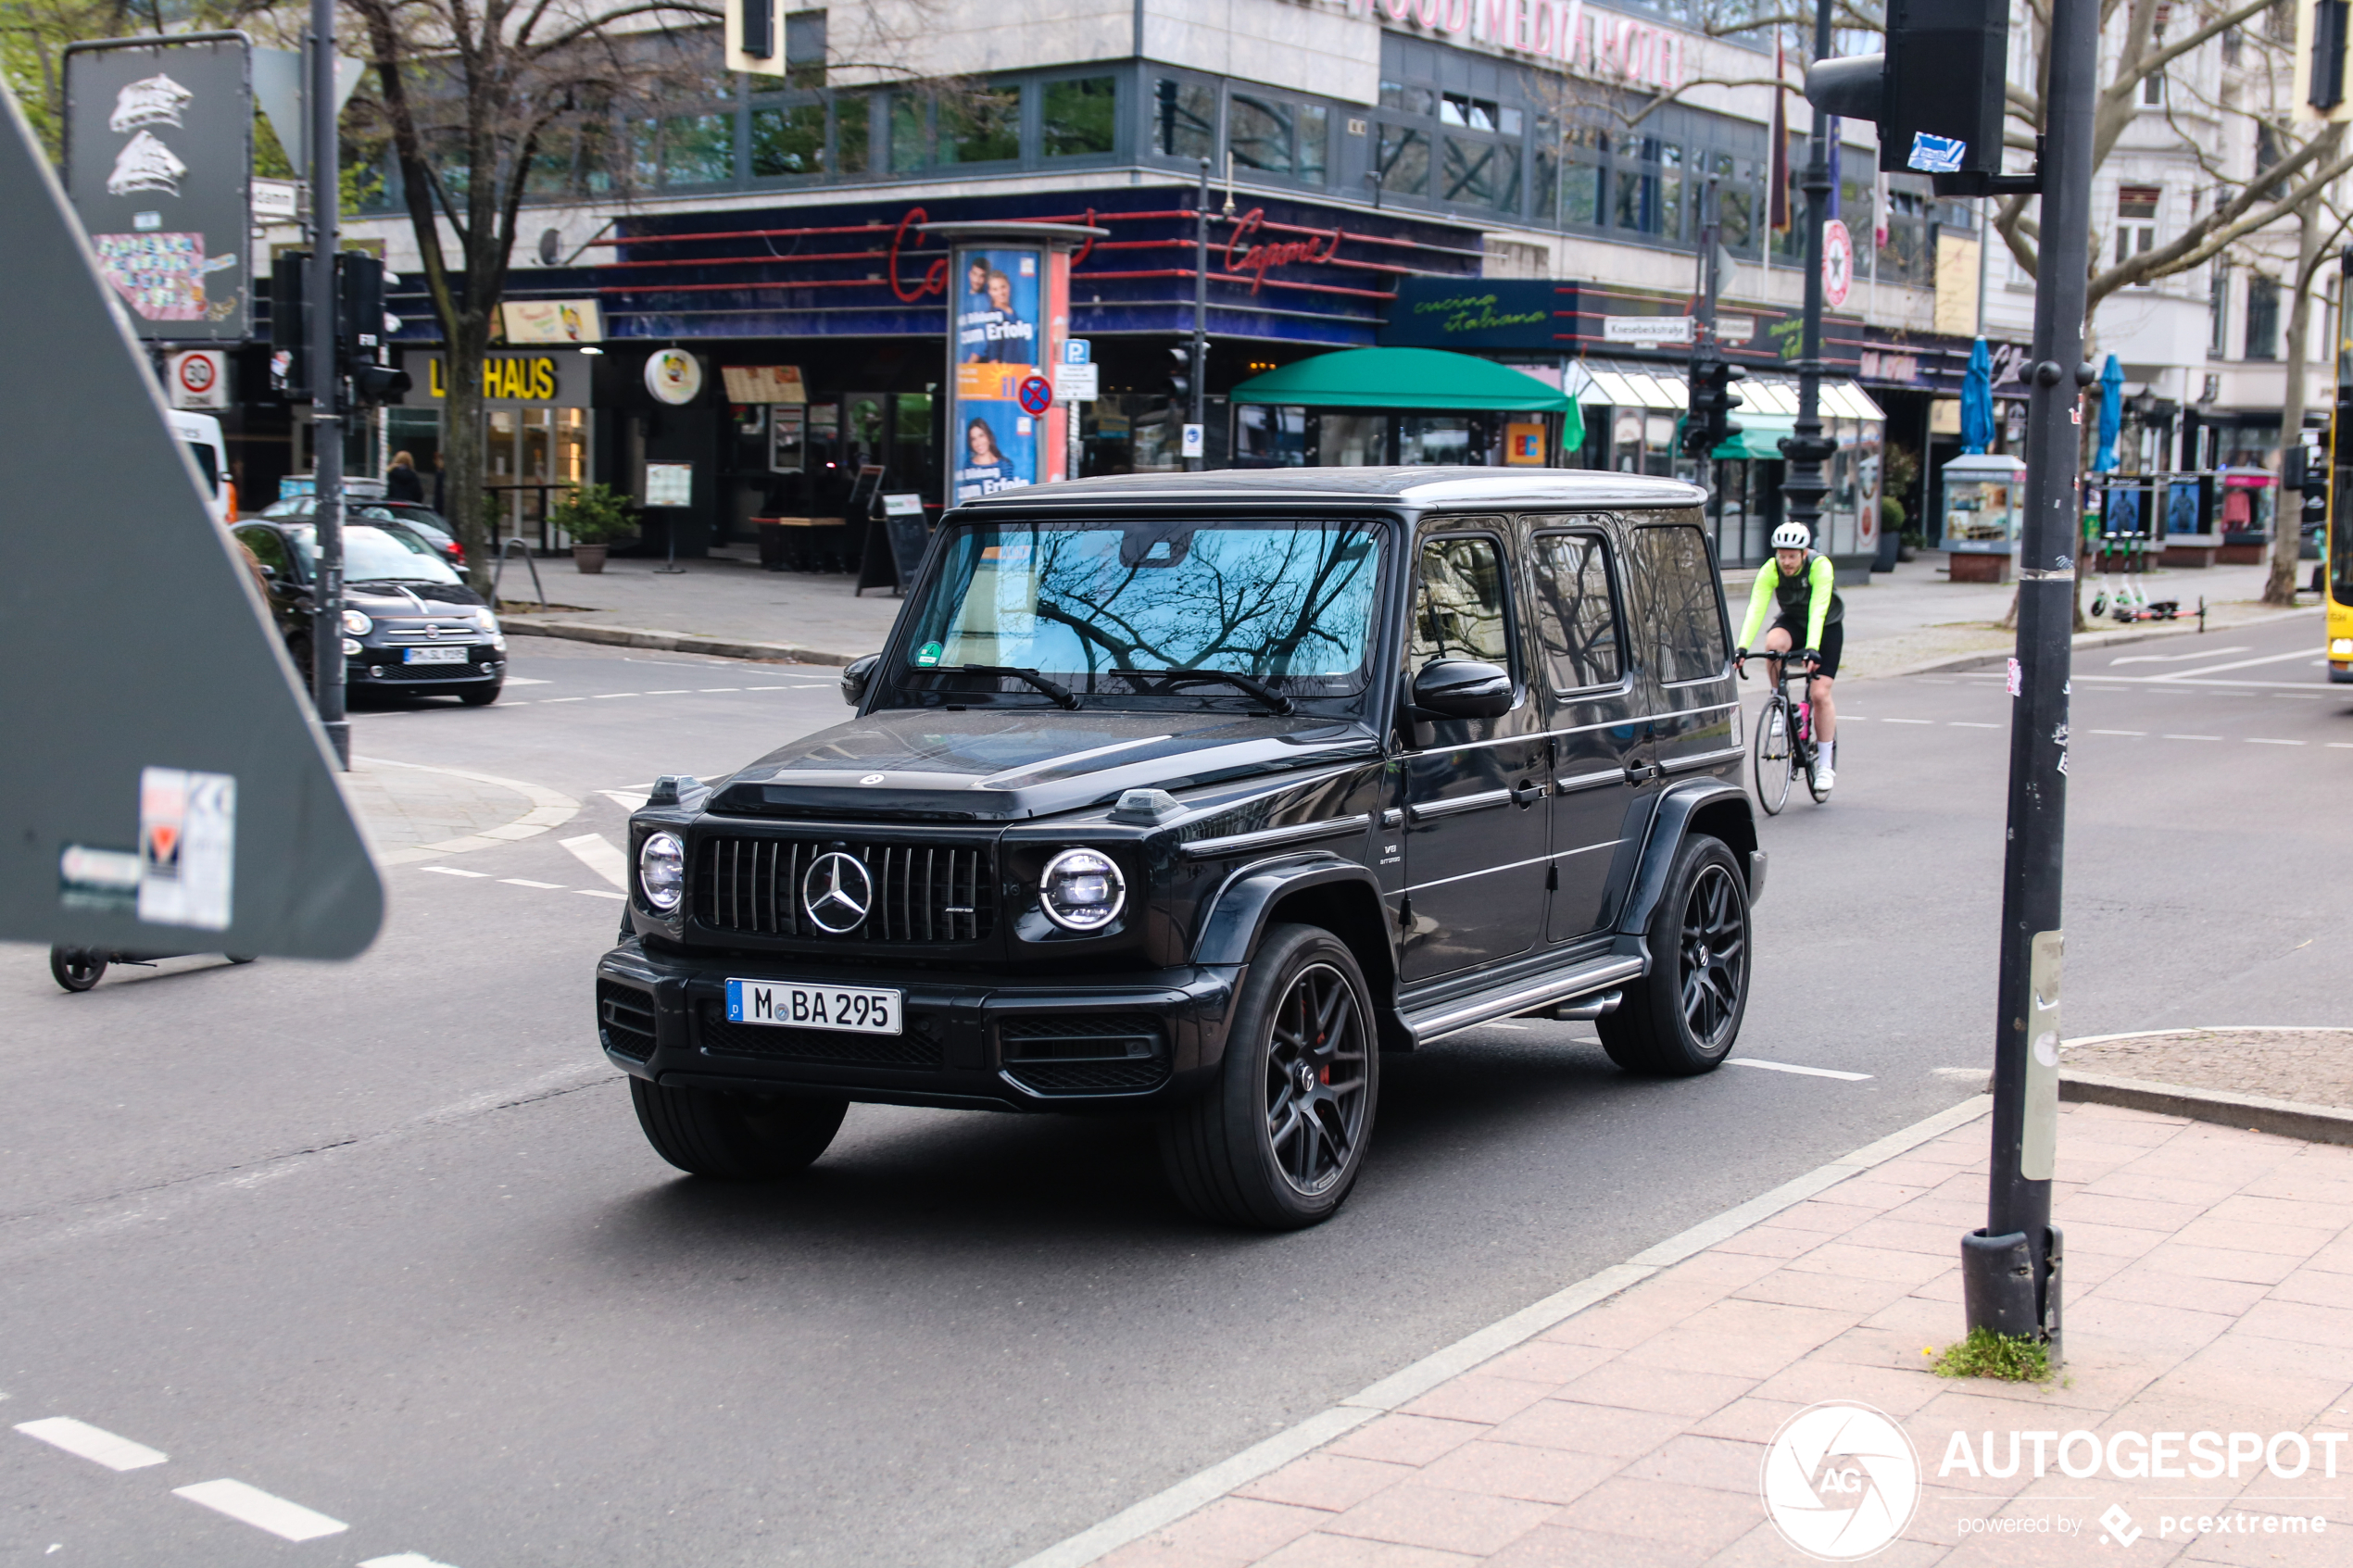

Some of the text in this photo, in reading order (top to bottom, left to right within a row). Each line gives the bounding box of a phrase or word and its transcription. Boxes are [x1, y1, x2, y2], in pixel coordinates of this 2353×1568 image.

[1225, 207, 1343, 296] Capone
[1413, 294, 1498, 314] cucina
[1443, 306, 1546, 332] italiana
[986, 320, 1033, 341] Erfolg
[1612, 323, 1685, 337] Knesebeckstraße
[1067, 343, 1085, 362] P
[186, 364, 208, 383] 30
[1516, 435, 1538, 456] EC
[1384, 844, 1397, 854] V8
[732, 986, 888, 1027] D M BA 295
